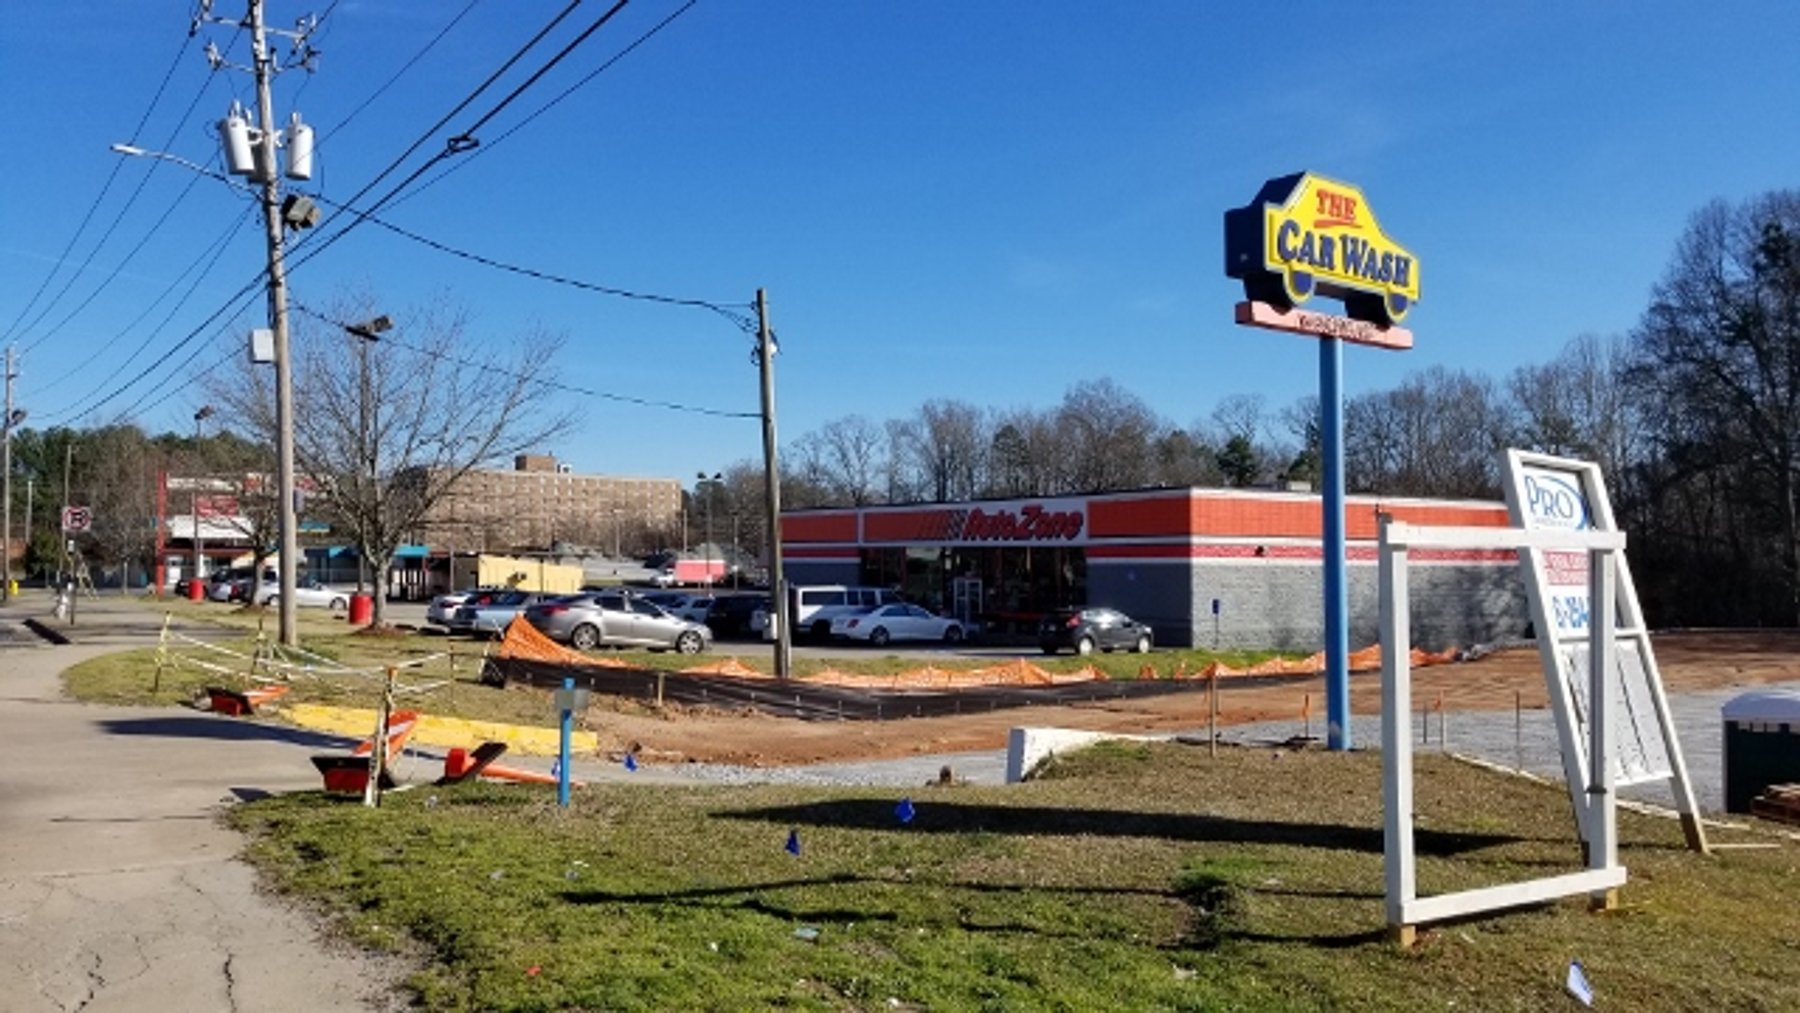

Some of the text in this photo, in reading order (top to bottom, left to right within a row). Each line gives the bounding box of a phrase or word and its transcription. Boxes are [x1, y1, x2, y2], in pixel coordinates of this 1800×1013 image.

[1316, 189, 1357, 221] THE
[1277, 219, 1413, 288] CAR WASH
[1524, 475, 1573, 519] PRO
[962, 504, 1084, 541] AutoZone
